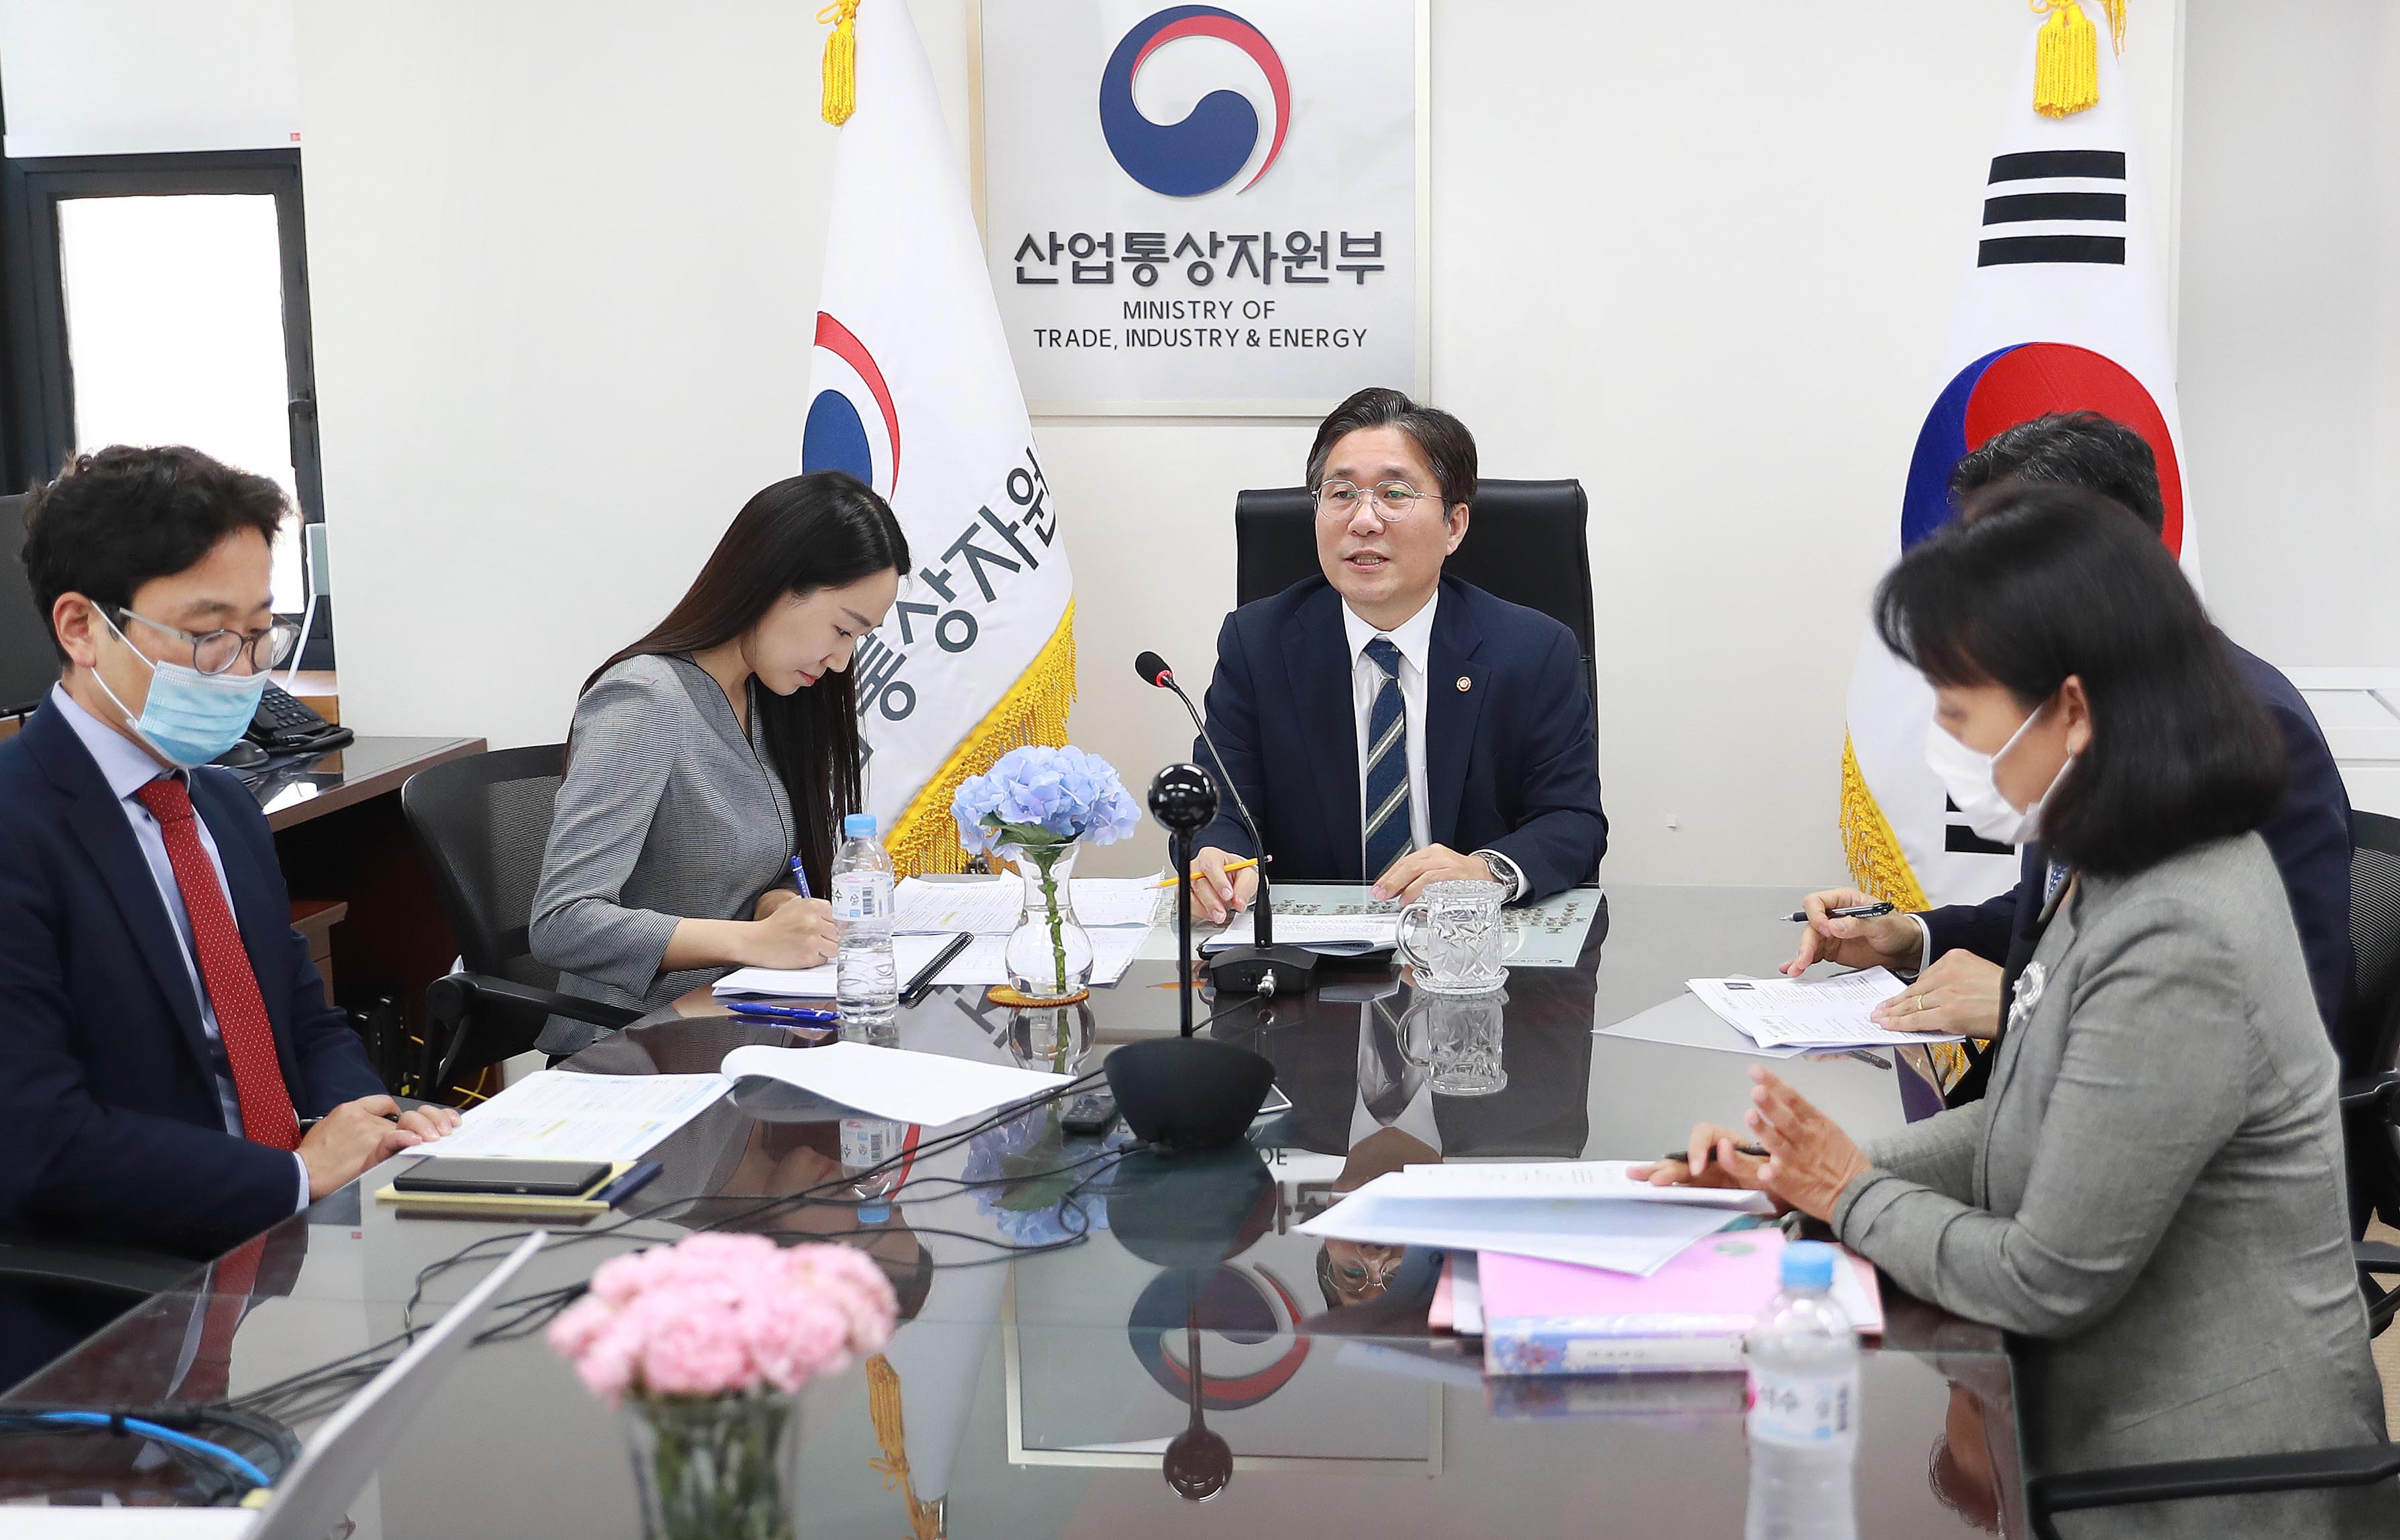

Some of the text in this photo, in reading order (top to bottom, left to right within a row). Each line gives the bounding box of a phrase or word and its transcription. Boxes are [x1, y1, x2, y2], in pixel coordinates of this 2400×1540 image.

[1014, 231, 1385, 287] 산업통상자원부
[1123, 300, 1275, 320] MINISTRY OF
[1033, 329, 1367, 350] TRADE, INDUSTRY & ENERGY
[855, 439, 1056, 770] 통상자원
